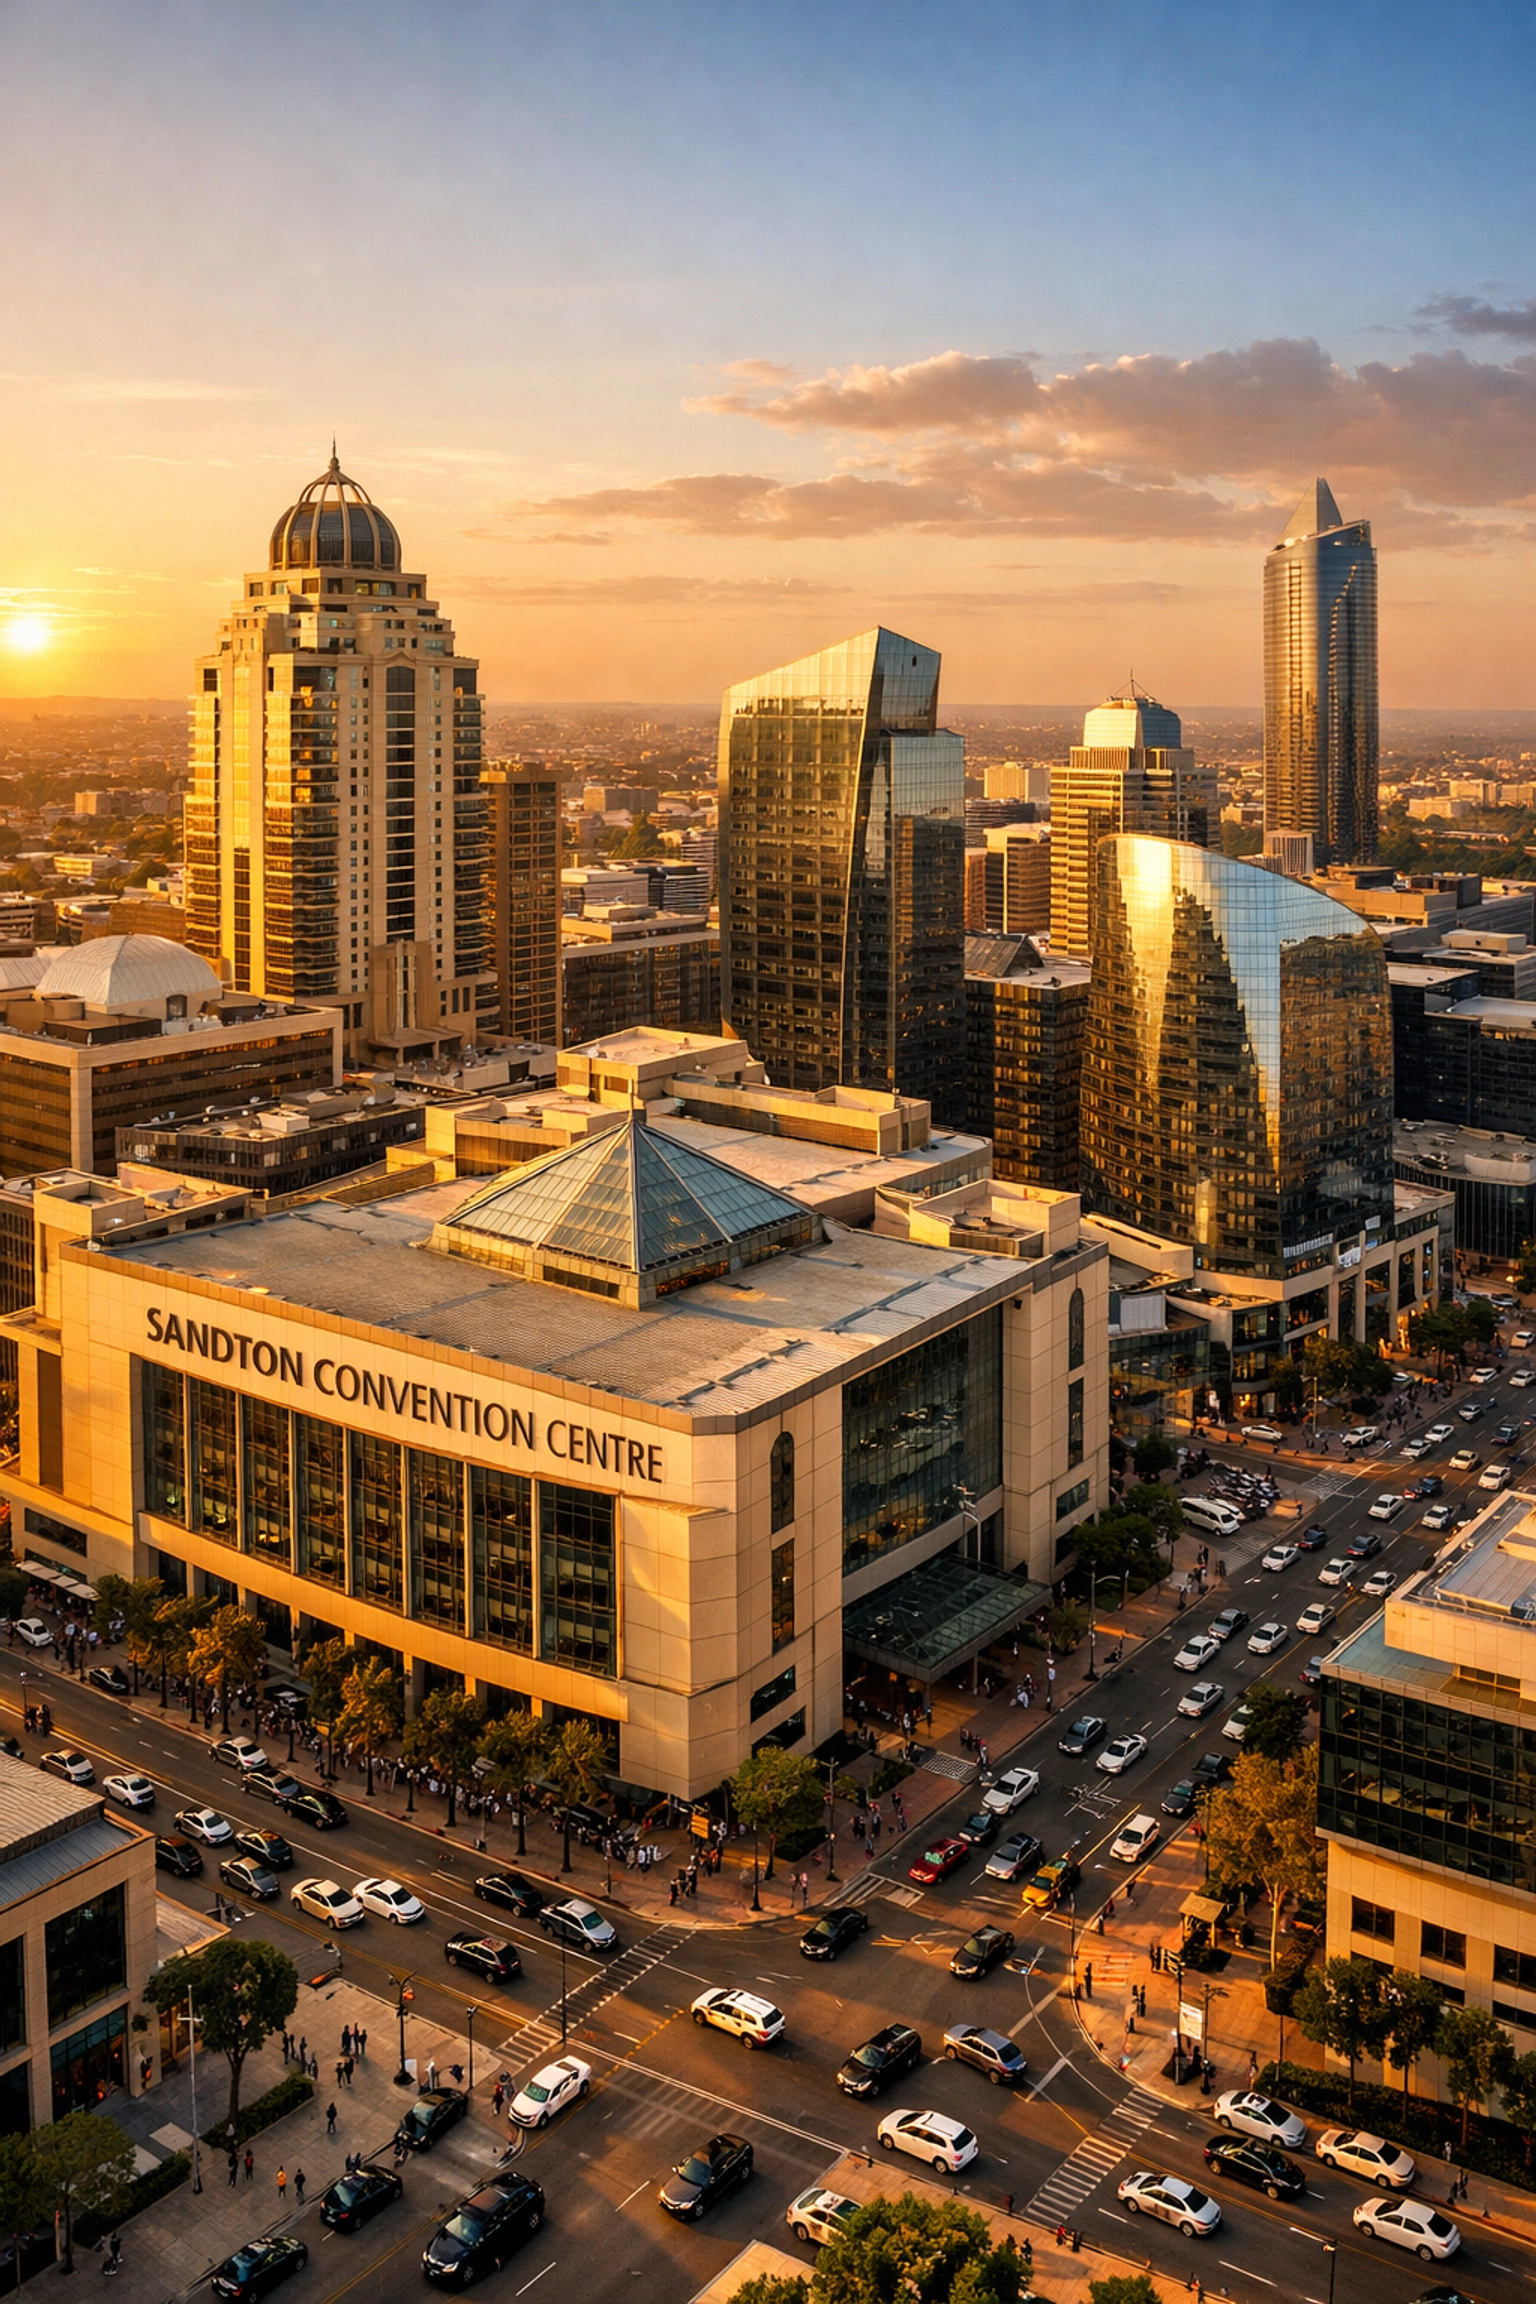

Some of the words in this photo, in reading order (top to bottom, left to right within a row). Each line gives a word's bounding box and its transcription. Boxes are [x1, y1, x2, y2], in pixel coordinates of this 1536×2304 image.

[146, 1306, 303, 1386] SANDTON
[314, 1358, 536, 1449] CONVENTION
[547, 1418, 664, 1484] CENTRE
